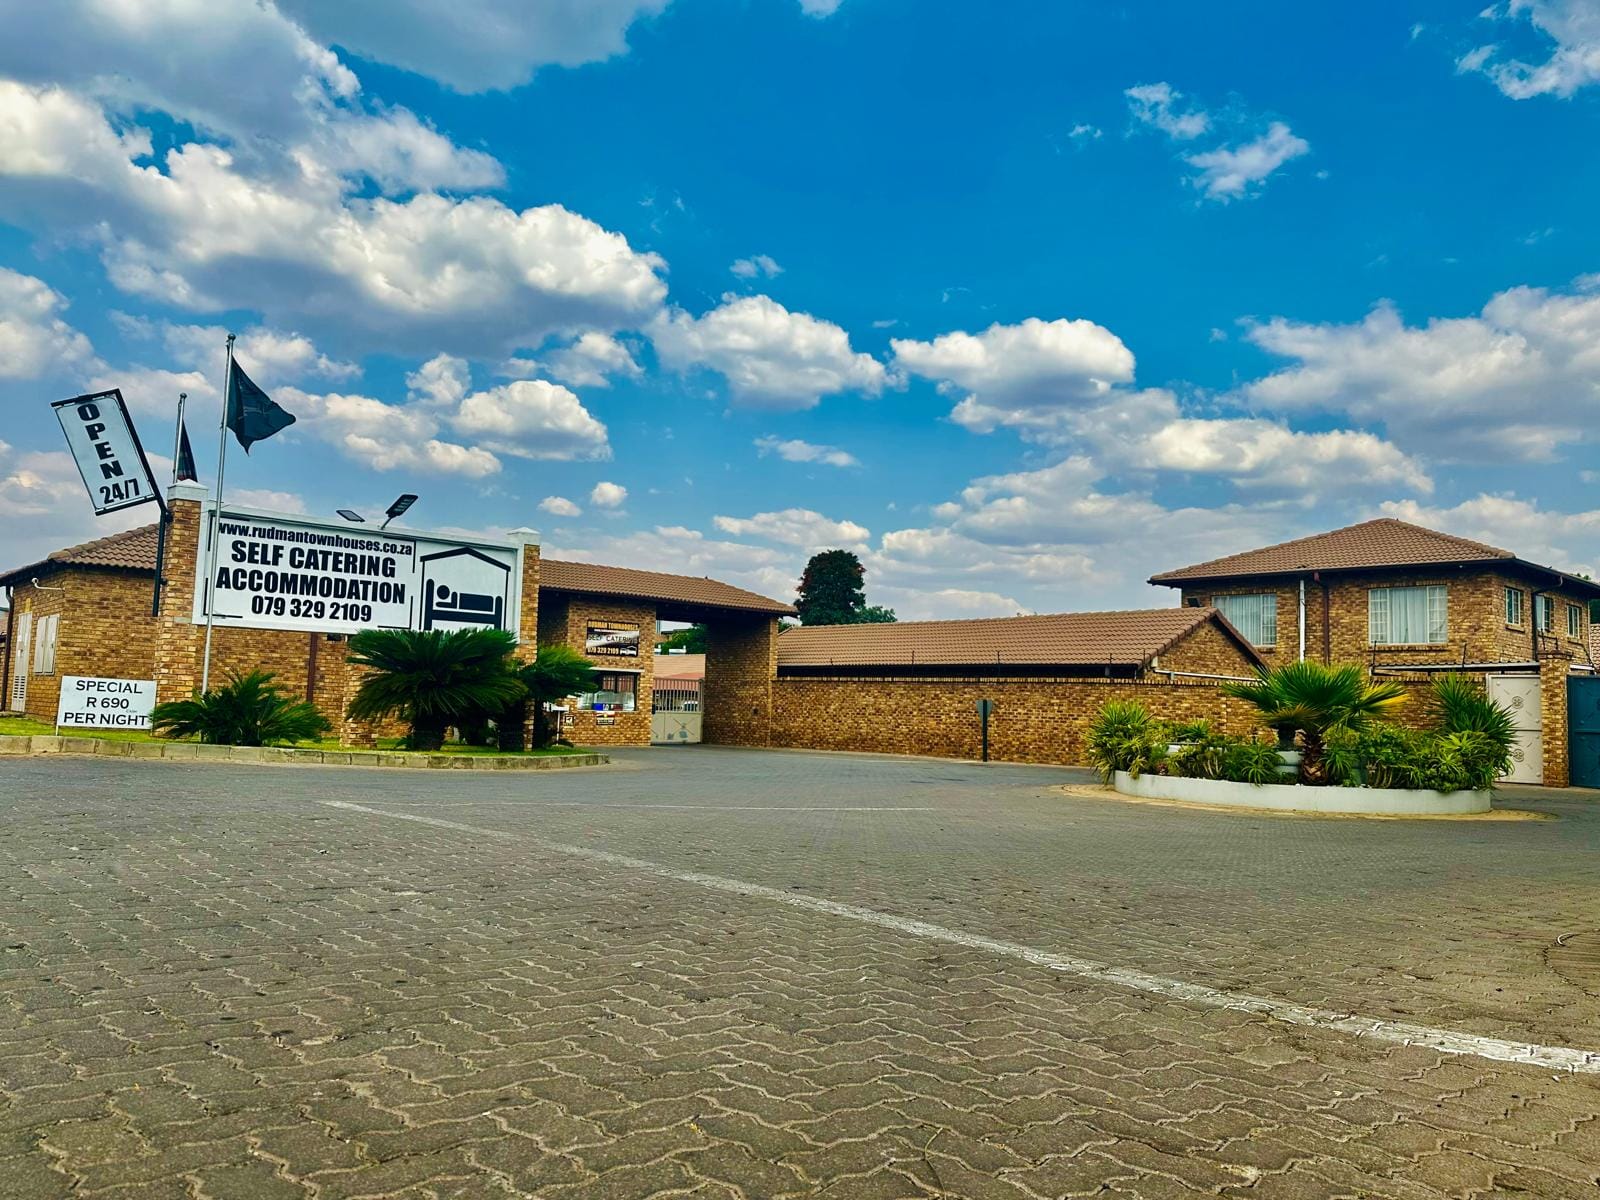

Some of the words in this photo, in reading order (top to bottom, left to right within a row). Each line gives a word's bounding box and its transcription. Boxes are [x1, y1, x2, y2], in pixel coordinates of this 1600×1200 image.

[77, 403, 124, 479] OPEN
[99, 478, 140, 504] 24/7
[218, 522, 412, 555] www.rudmantownhouses.co.za
[231, 540, 285, 566] SELF
[289, 547, 396, 578] CATERING
[215, 567, 406, 604] ACCOMMODATION
[251, 595, 286, 616] 079
[290, 599, 325, 619] 329
[329, 602, 372, 622] 2109
[75, 680, 143, 694] SPECIAL
[86, 697, 97, 708] R
[101, 697, 130, 709] 690
[63, 712, 96, 724] PER
[100, 713, 149, 726] NIGHT
